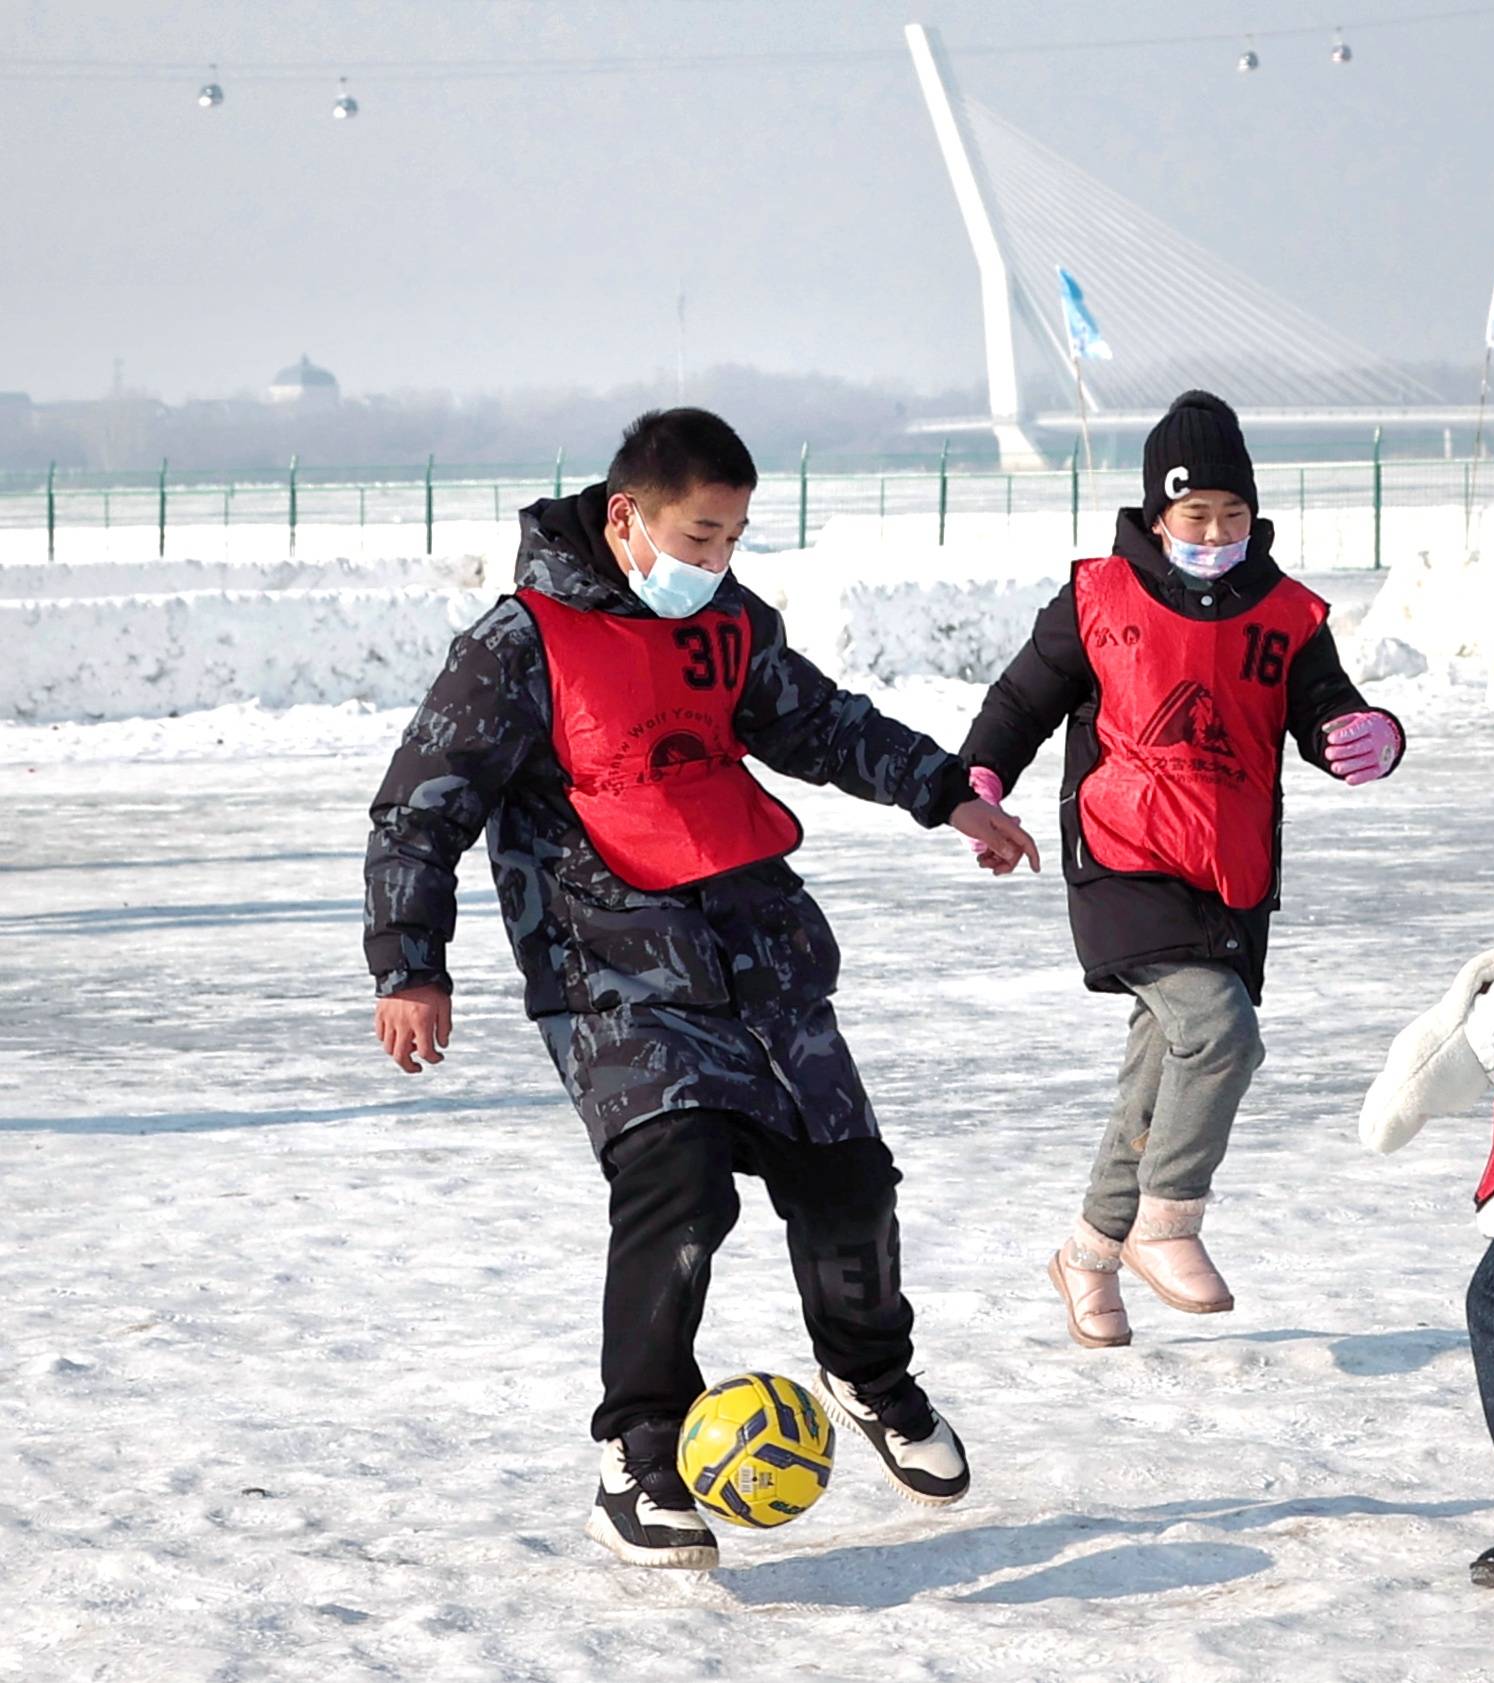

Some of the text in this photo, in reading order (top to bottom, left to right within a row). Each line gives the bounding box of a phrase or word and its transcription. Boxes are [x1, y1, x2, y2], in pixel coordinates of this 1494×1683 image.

[1163, 466, 1190, 500] C
[675, 623, 741, 690] 30
[1241, 622, 1290, 686] 16
